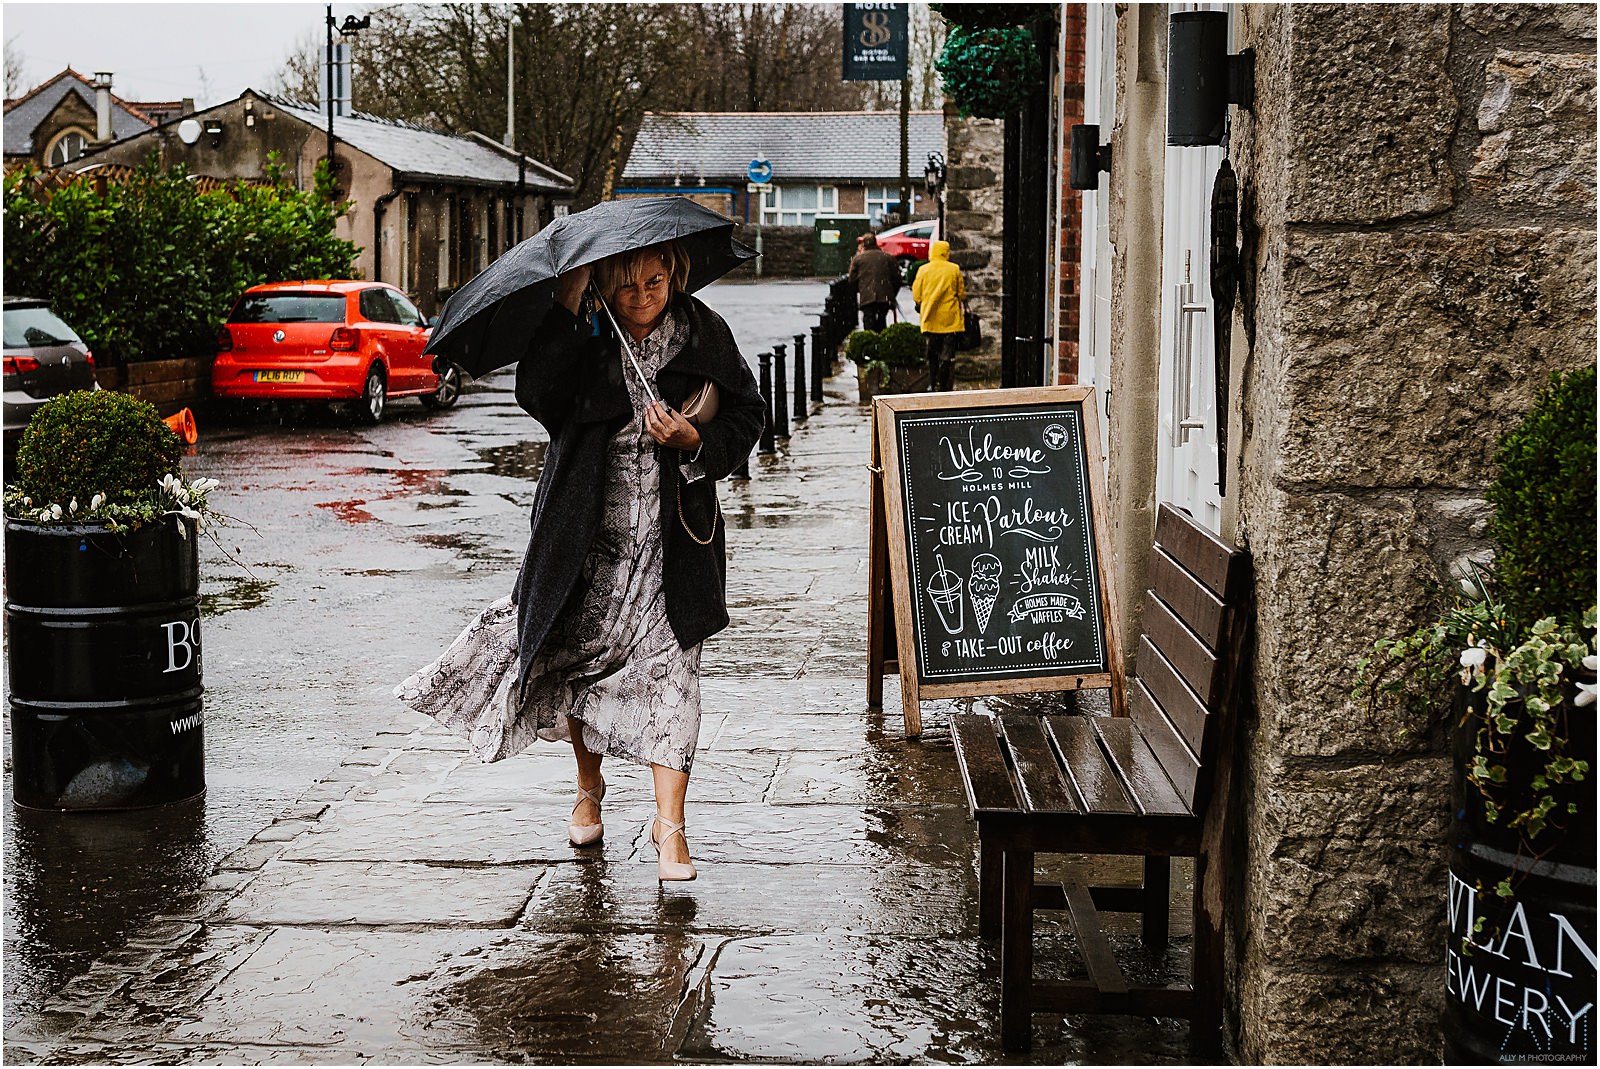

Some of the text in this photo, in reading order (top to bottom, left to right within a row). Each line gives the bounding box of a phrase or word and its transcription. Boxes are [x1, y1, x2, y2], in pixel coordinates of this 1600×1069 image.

[260, 370, 281, 381] PL16
[939, 426, 1046, 470] Welcome
[992, 468, 1003, 479] TO
[962, 482, 1032, 492] HOLMES MILL
[948, 501, 970, 524] ICE
[973, 495, 1075, 549] Parlour
[939, 525, 983, 545] CREAM
[1025, 545, 1060, 568] MILK
[1020, 561, 1073, 594] Shakes
[1024, 596, 1068, 609] HOLMES MADE
[1030, 610, 1064, 625] WAFFLES
[1026, 631, 1074, 660] coffee
